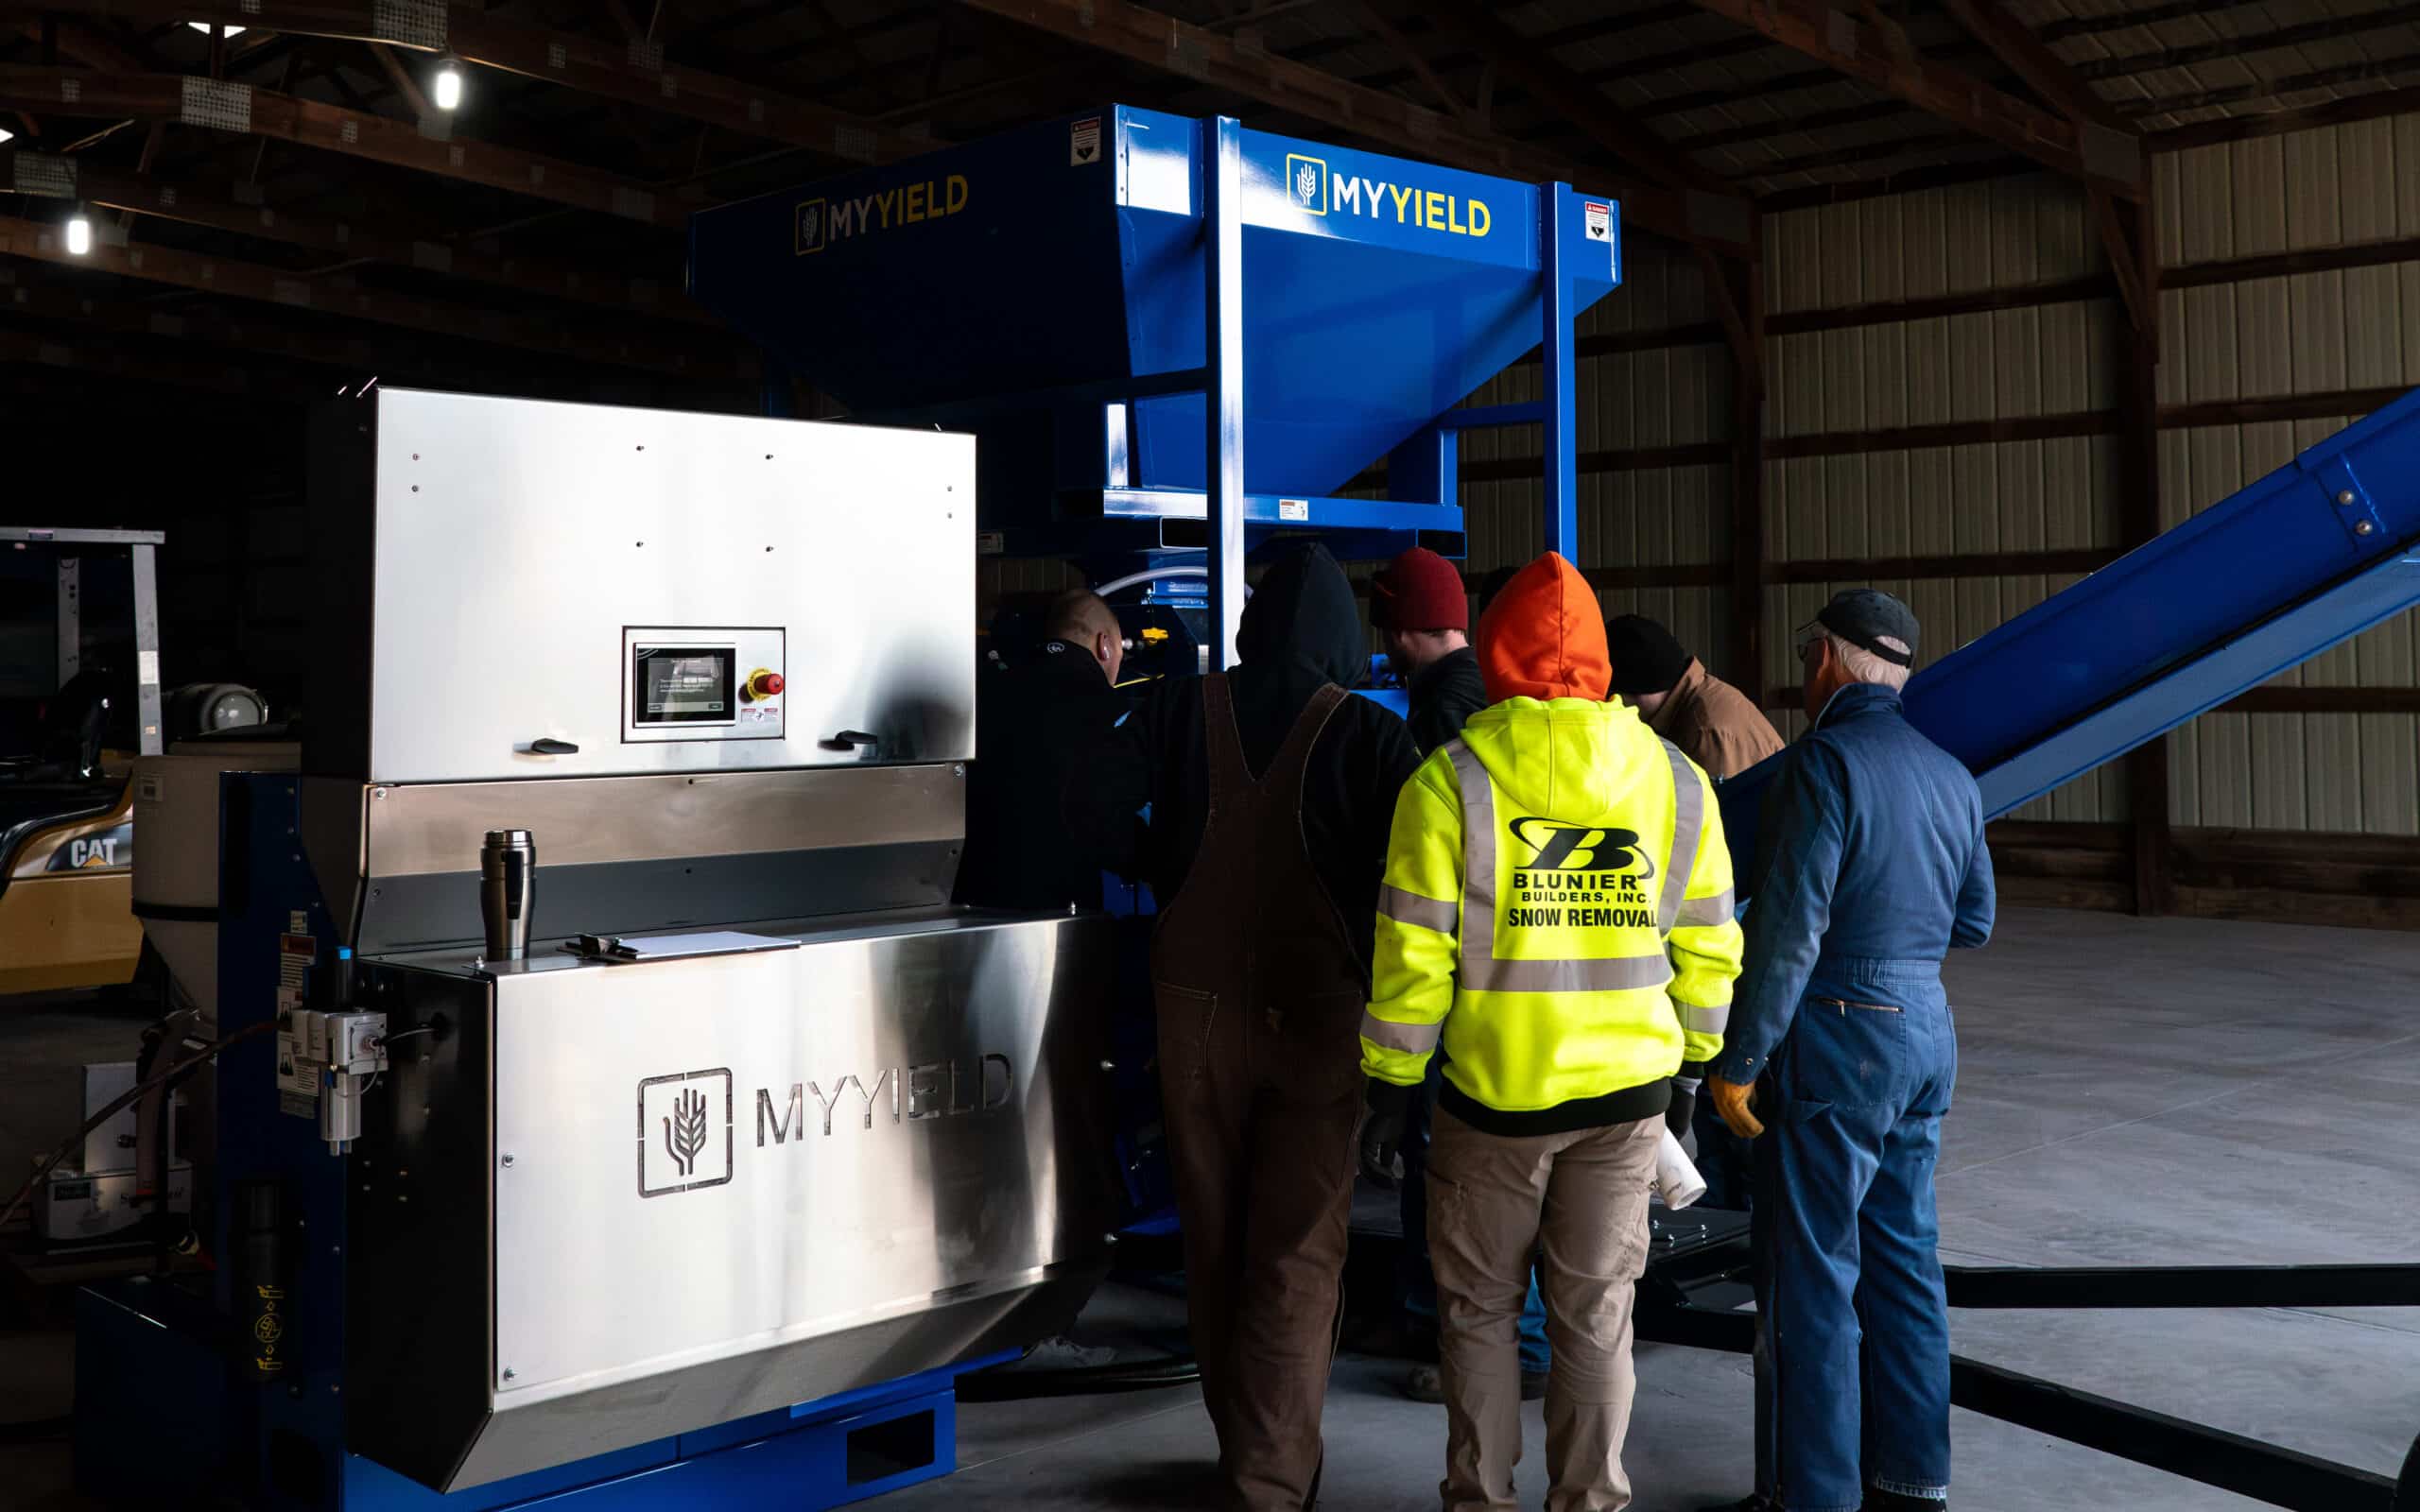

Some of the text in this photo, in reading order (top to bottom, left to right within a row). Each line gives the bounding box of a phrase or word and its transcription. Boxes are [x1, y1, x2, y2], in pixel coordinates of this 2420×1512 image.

[830, 174, 969, 242] MYYIELD
[1332, 172, 1491, 238] MYYIELD
[71, 838, 117, 868] CAT
[1512, 873, 1637, 890] BLUNIER
[1521, 891, 1610, 904] BUILDERS,
[1508, 908, 1656, 928] SNOW REMOVAL
[756, 1053, 1012, 1148] MYYIELD
